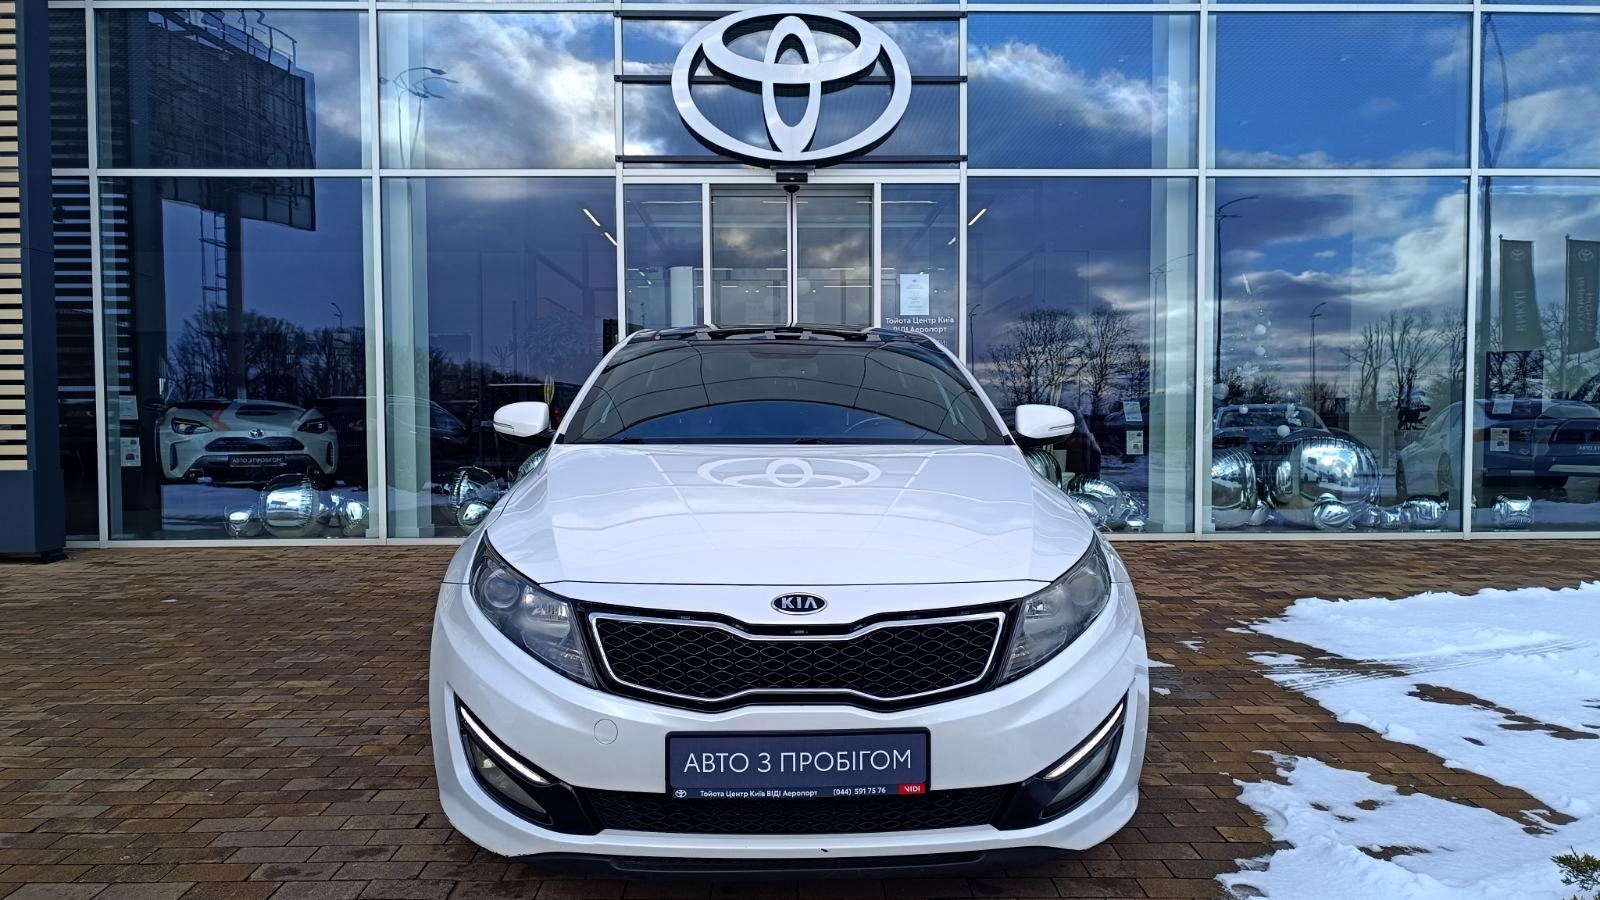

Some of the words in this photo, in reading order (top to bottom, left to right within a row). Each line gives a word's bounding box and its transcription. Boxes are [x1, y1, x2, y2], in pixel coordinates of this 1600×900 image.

[912, 317, 936, 325] Центр
[781, 596, 818, 609] KIA
[683, 752, 749, 773] АВТО
[757, 752, 771, 773] З
[780, 749, 911, 772] ПРОБІГОМ
[726, 790, 749, 799] Центр
[750, 789, 765, 797] Київ
[783, 789, 818, 798] Аеропорт
[833, 788, 852, 796] (044)
[855, 787, 866, 795] 591
[867, 787, 876, 795] 75
